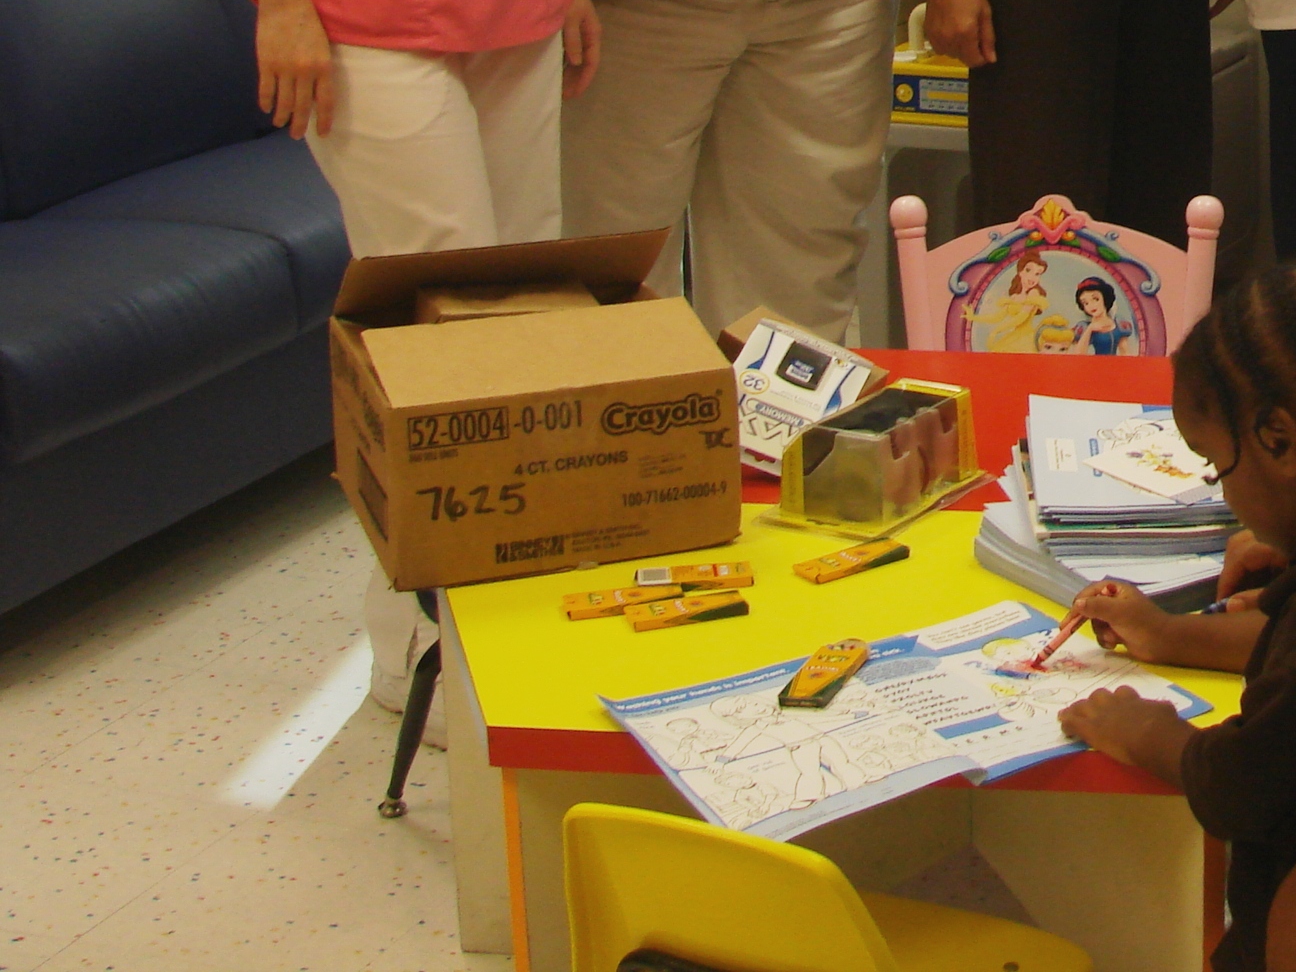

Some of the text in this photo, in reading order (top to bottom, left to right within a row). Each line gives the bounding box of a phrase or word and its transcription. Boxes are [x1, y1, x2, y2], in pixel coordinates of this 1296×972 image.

[743, 374, 766, 391] 32
[411, 410, 508, 448] 52-0004
[603, 395, 720, 434] Crayola
[759, 405, 800, 427] MEMORY
[514, 464, 523, 476] 4
[527, 459, 550, 475] CT.
[555, 451, 628, 471] CRAYONS
[416, 482, 526, 522] 7625
